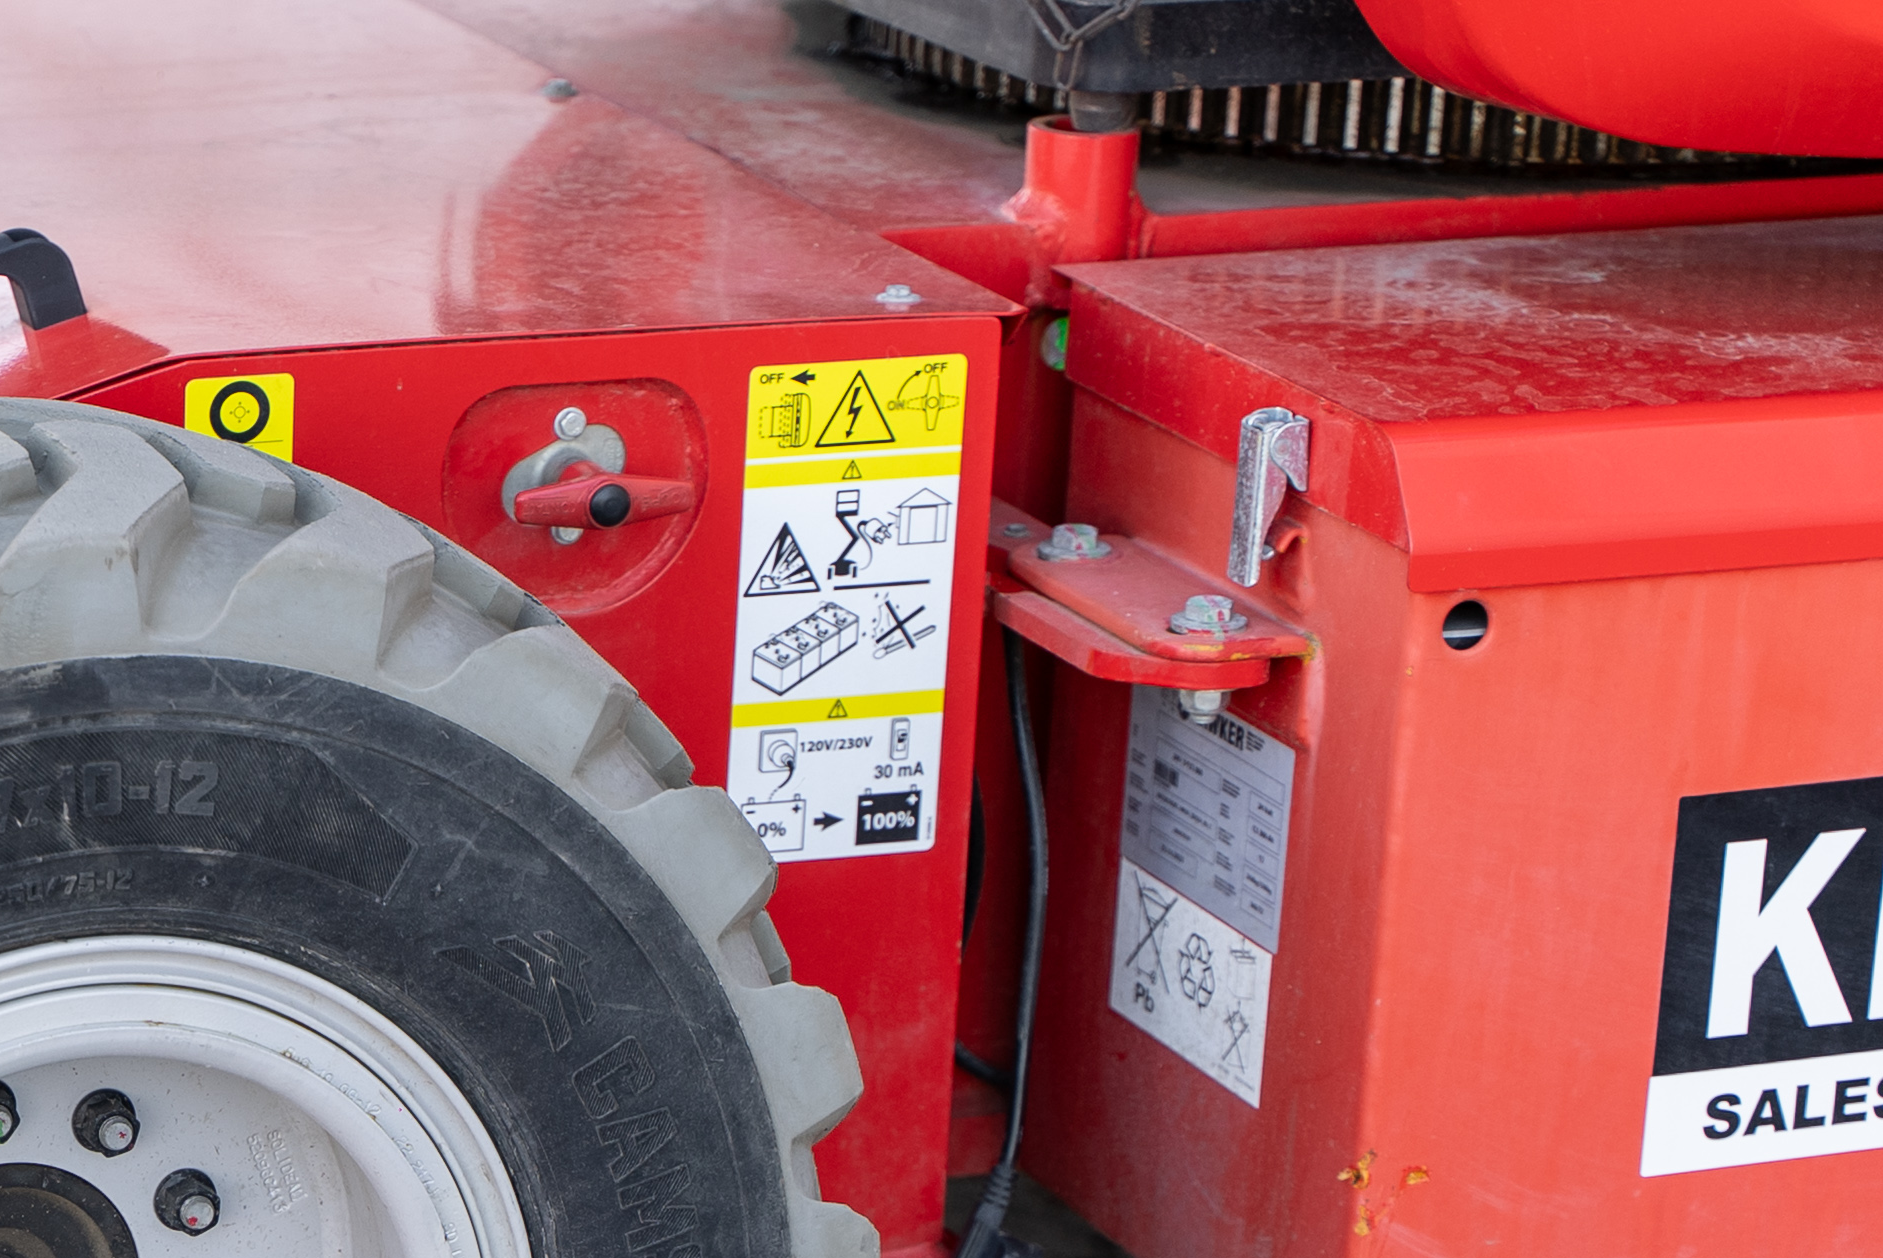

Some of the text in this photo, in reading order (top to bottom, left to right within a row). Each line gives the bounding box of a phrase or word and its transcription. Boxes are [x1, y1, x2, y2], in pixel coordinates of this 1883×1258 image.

[924, 362, 948, 374] OFF
[760, 372, 785, 385] OFF
[799, 736, 873, 753] 120V/230V
[874, 761, 924, 779] 30 mA
[861, 811, 916, 831] 100%
[1705, 827, 1883, 1040] K
